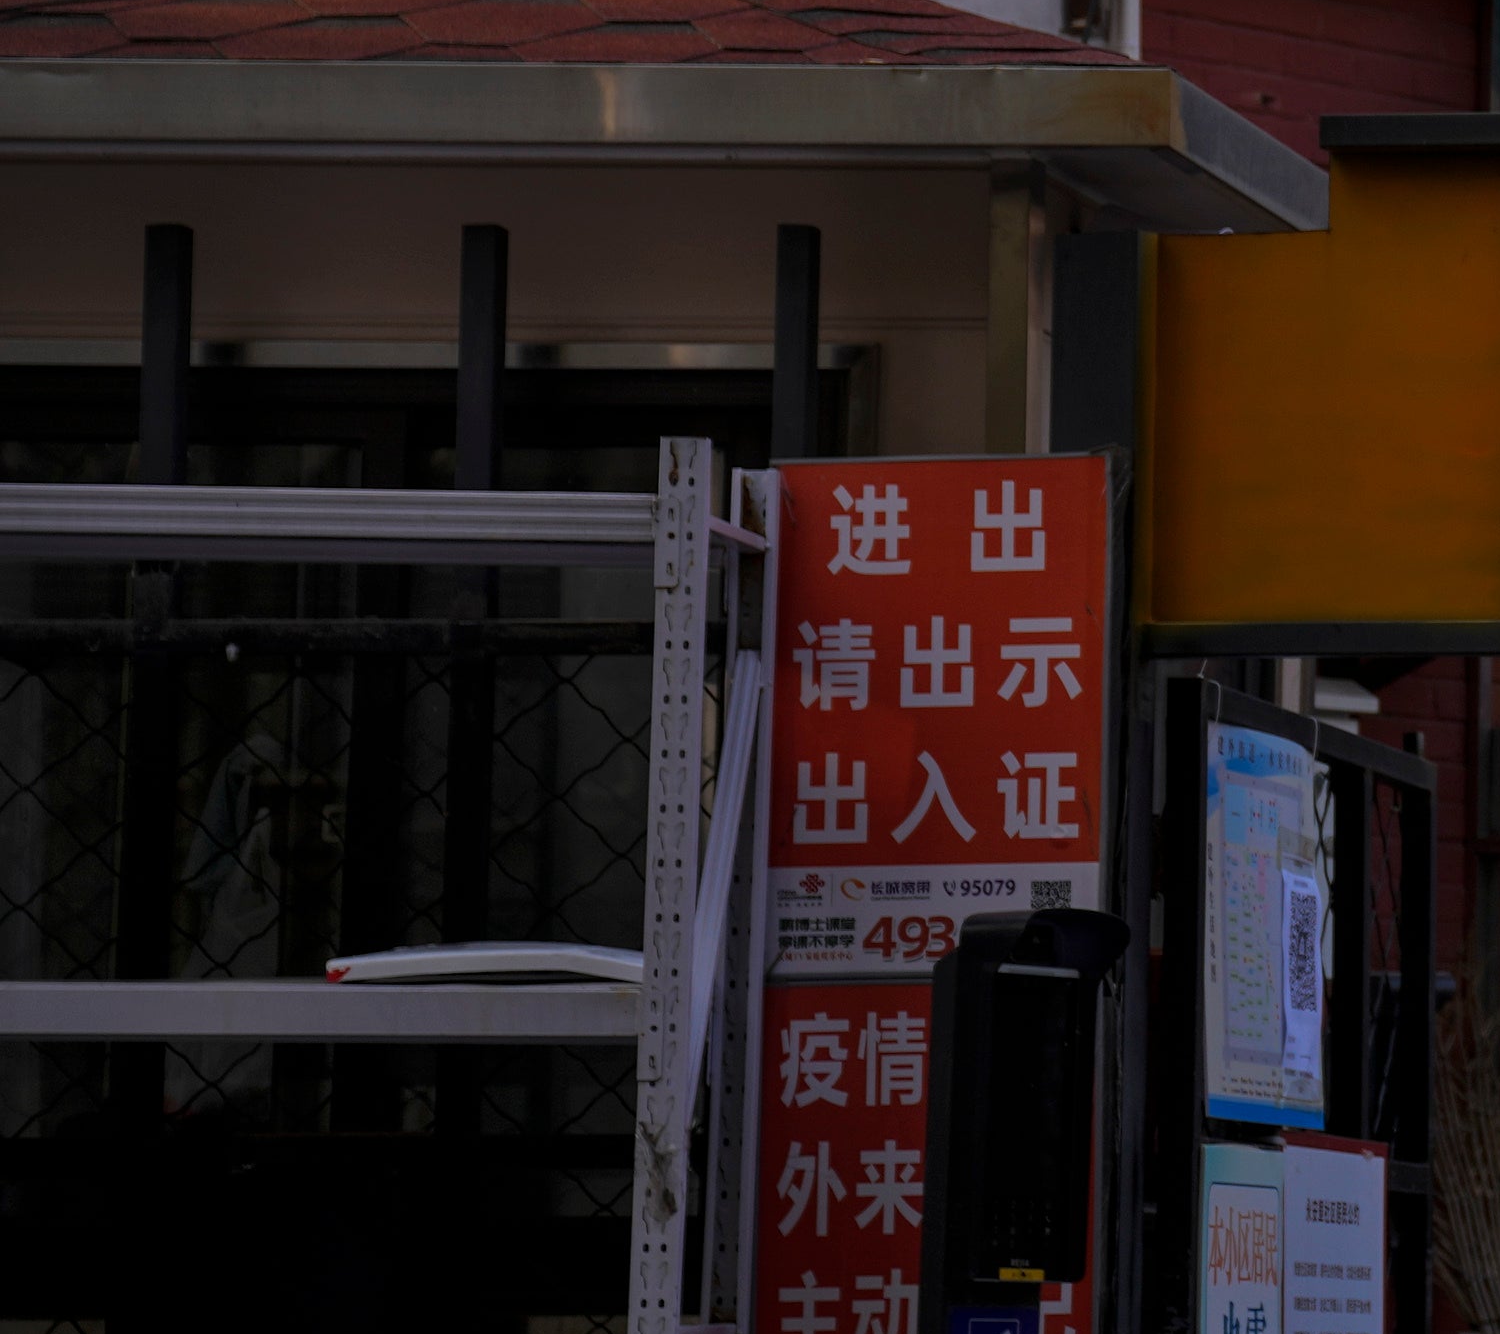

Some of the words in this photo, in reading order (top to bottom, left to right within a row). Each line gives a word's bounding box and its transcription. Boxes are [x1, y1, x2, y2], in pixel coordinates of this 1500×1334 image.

[828, 480, 1046, 575] 进出
[792, 614, 1082, 713] 请出示
[792, 749, 1080, 846] 出入证
[960, 879, 1016, 897] 95079
[778, 1011, 927, 1109] 疫情
[776, 1143, 924, 1237] 外来
[1208, 1205, 1278, 1287] 本小区居民
